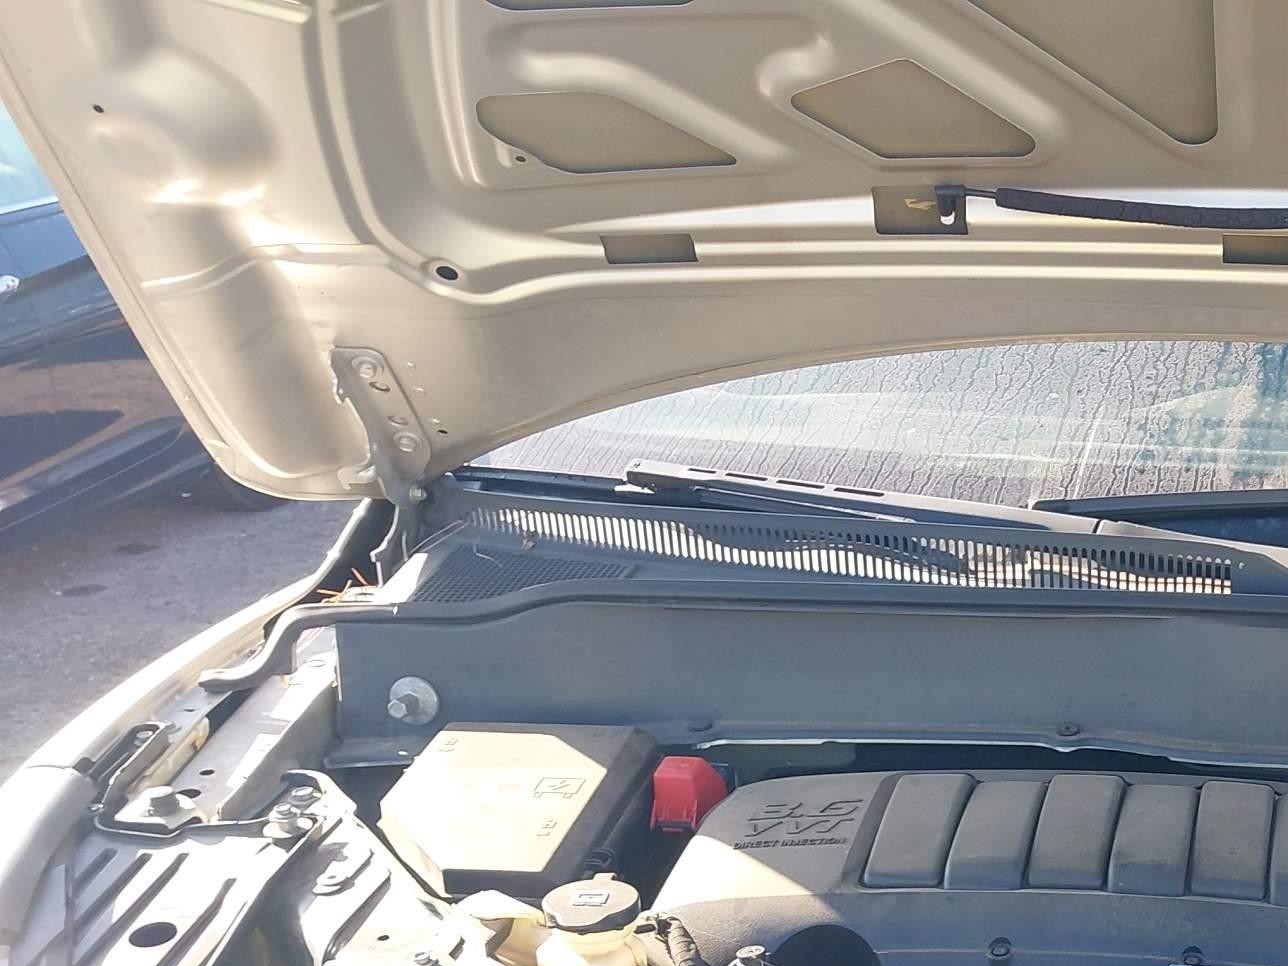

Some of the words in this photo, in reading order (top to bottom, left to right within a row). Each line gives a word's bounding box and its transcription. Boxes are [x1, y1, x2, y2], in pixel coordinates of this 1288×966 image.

[747, 799, 863, 821] 3.6
[745, 818, 855, 837] VVT
[733, 839, 780, 850] DIRECT
[781, 837, 849, 848] INJECTION
